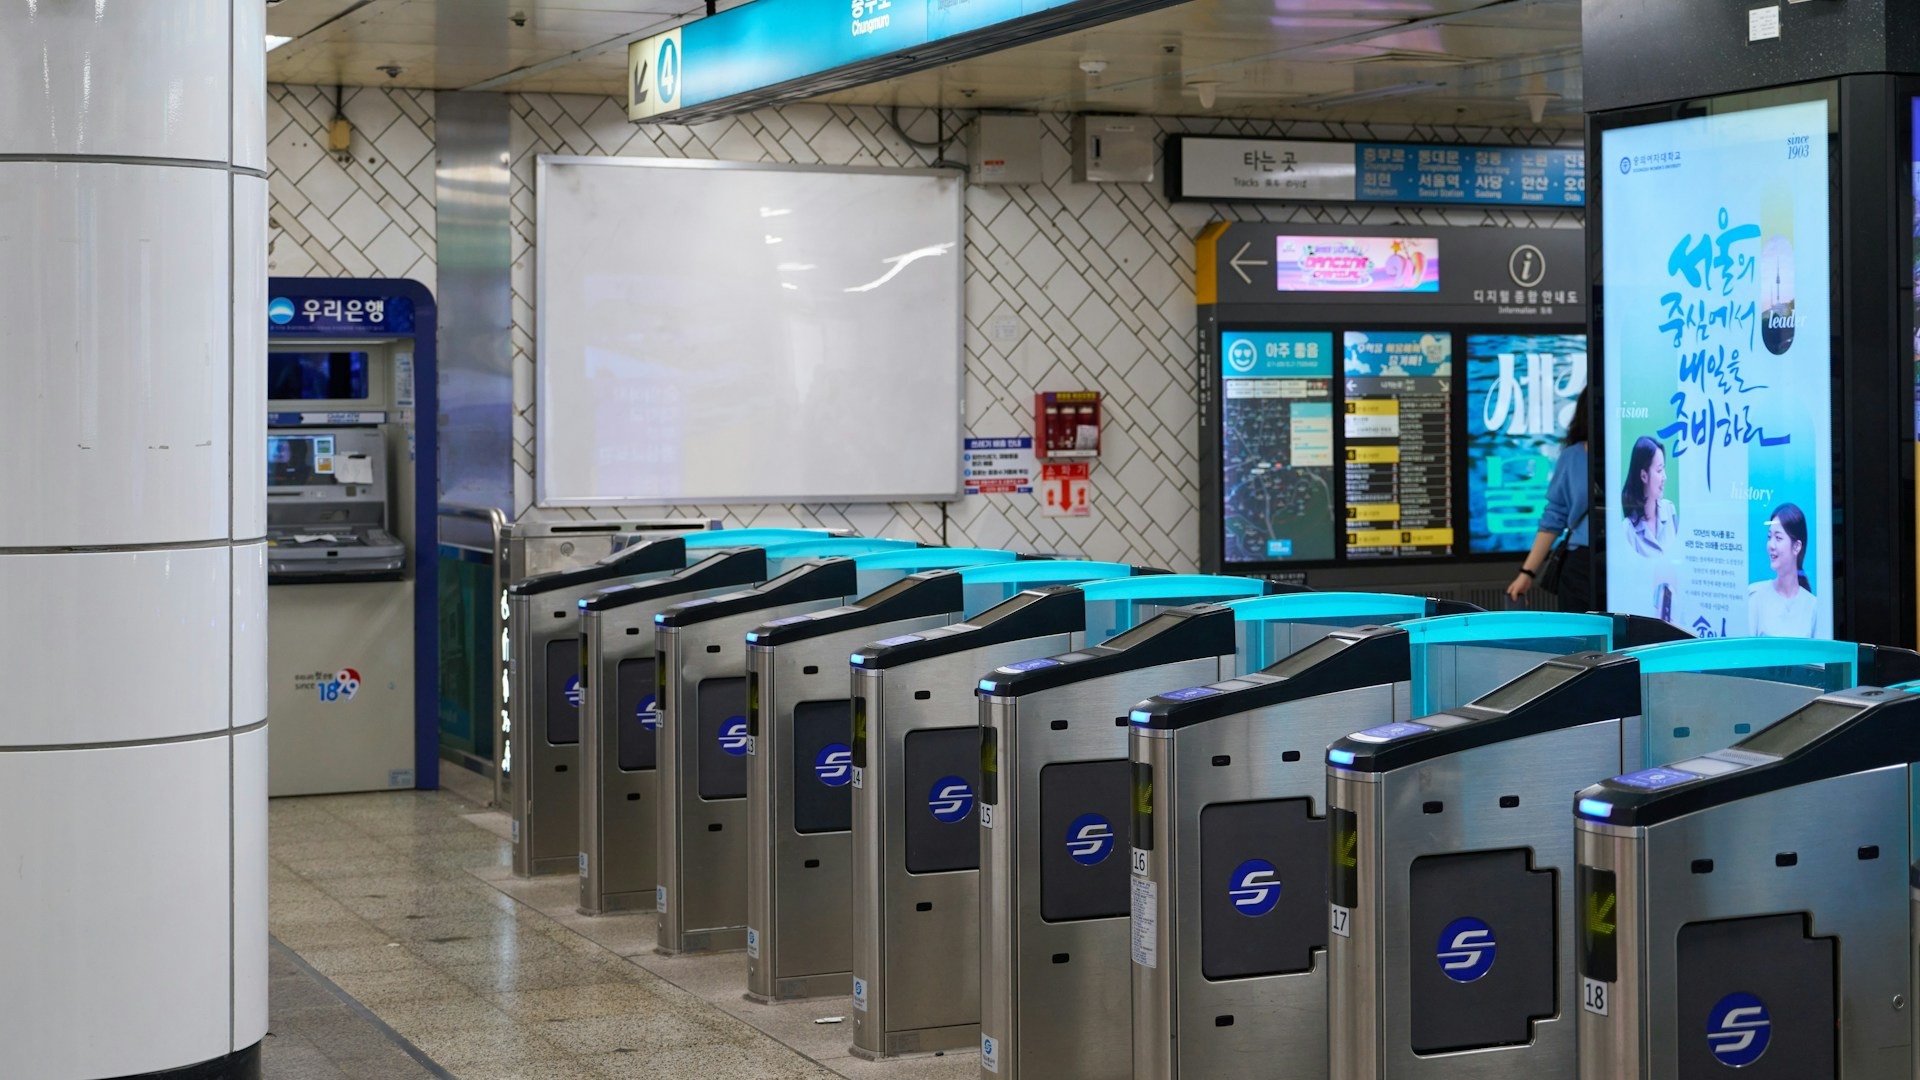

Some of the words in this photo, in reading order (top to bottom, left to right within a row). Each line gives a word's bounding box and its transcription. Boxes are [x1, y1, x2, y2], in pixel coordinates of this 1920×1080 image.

[851, 14, 890, 36] Chungmuro
[661, 44, 675, 96] 4
[1787, 133, 1809, 145] since
[1244, 150, 1276, 172] 타는
[1281, 151, 1298, 172] 곳
[1633, 151, 1681, 167] 숭의여자대학교
[1788, 145, 1809, 160] 1903
[1233, 177, 1259, 188] Tracks
[1419, 174, 1460, 188] 서울역
[1475, 176, 1503, 190] 사당
[1522, 177, 1549, 191] 안산
[1668, 207, 1761, 296] 서울의
[1473, 290, 1509, 304] 디지털
[1542, 290, 1578, 304] 안내도
[302, 299, 384, 323] 우리은행
[1498, 306, 1536, 314] Information
[1768, 310, 1806, 329] leader
[1658, 292, 1756, 352] 중심에서
[1266, 342, 1290, 359] 아주
[1679, 345, 1769, 394] 내일을
[1616, 401, 1648, 419] vision
[971, 440, 991, 449] 쓰레기
[1007, 439, 1022, 447] 안내
[1657, 391, 1791, 491] 준비하라
[1730, 481, 1774, 506] history
[318, 669, 360, 702] 1899
[852, 769, 861, 785] 14
[981, 806, 991, 824] 15
[1134, 851, 1146, 872] 16
[1333, 910, 1347, 931] 17
[1585, 983, 1604, 1010] 18
